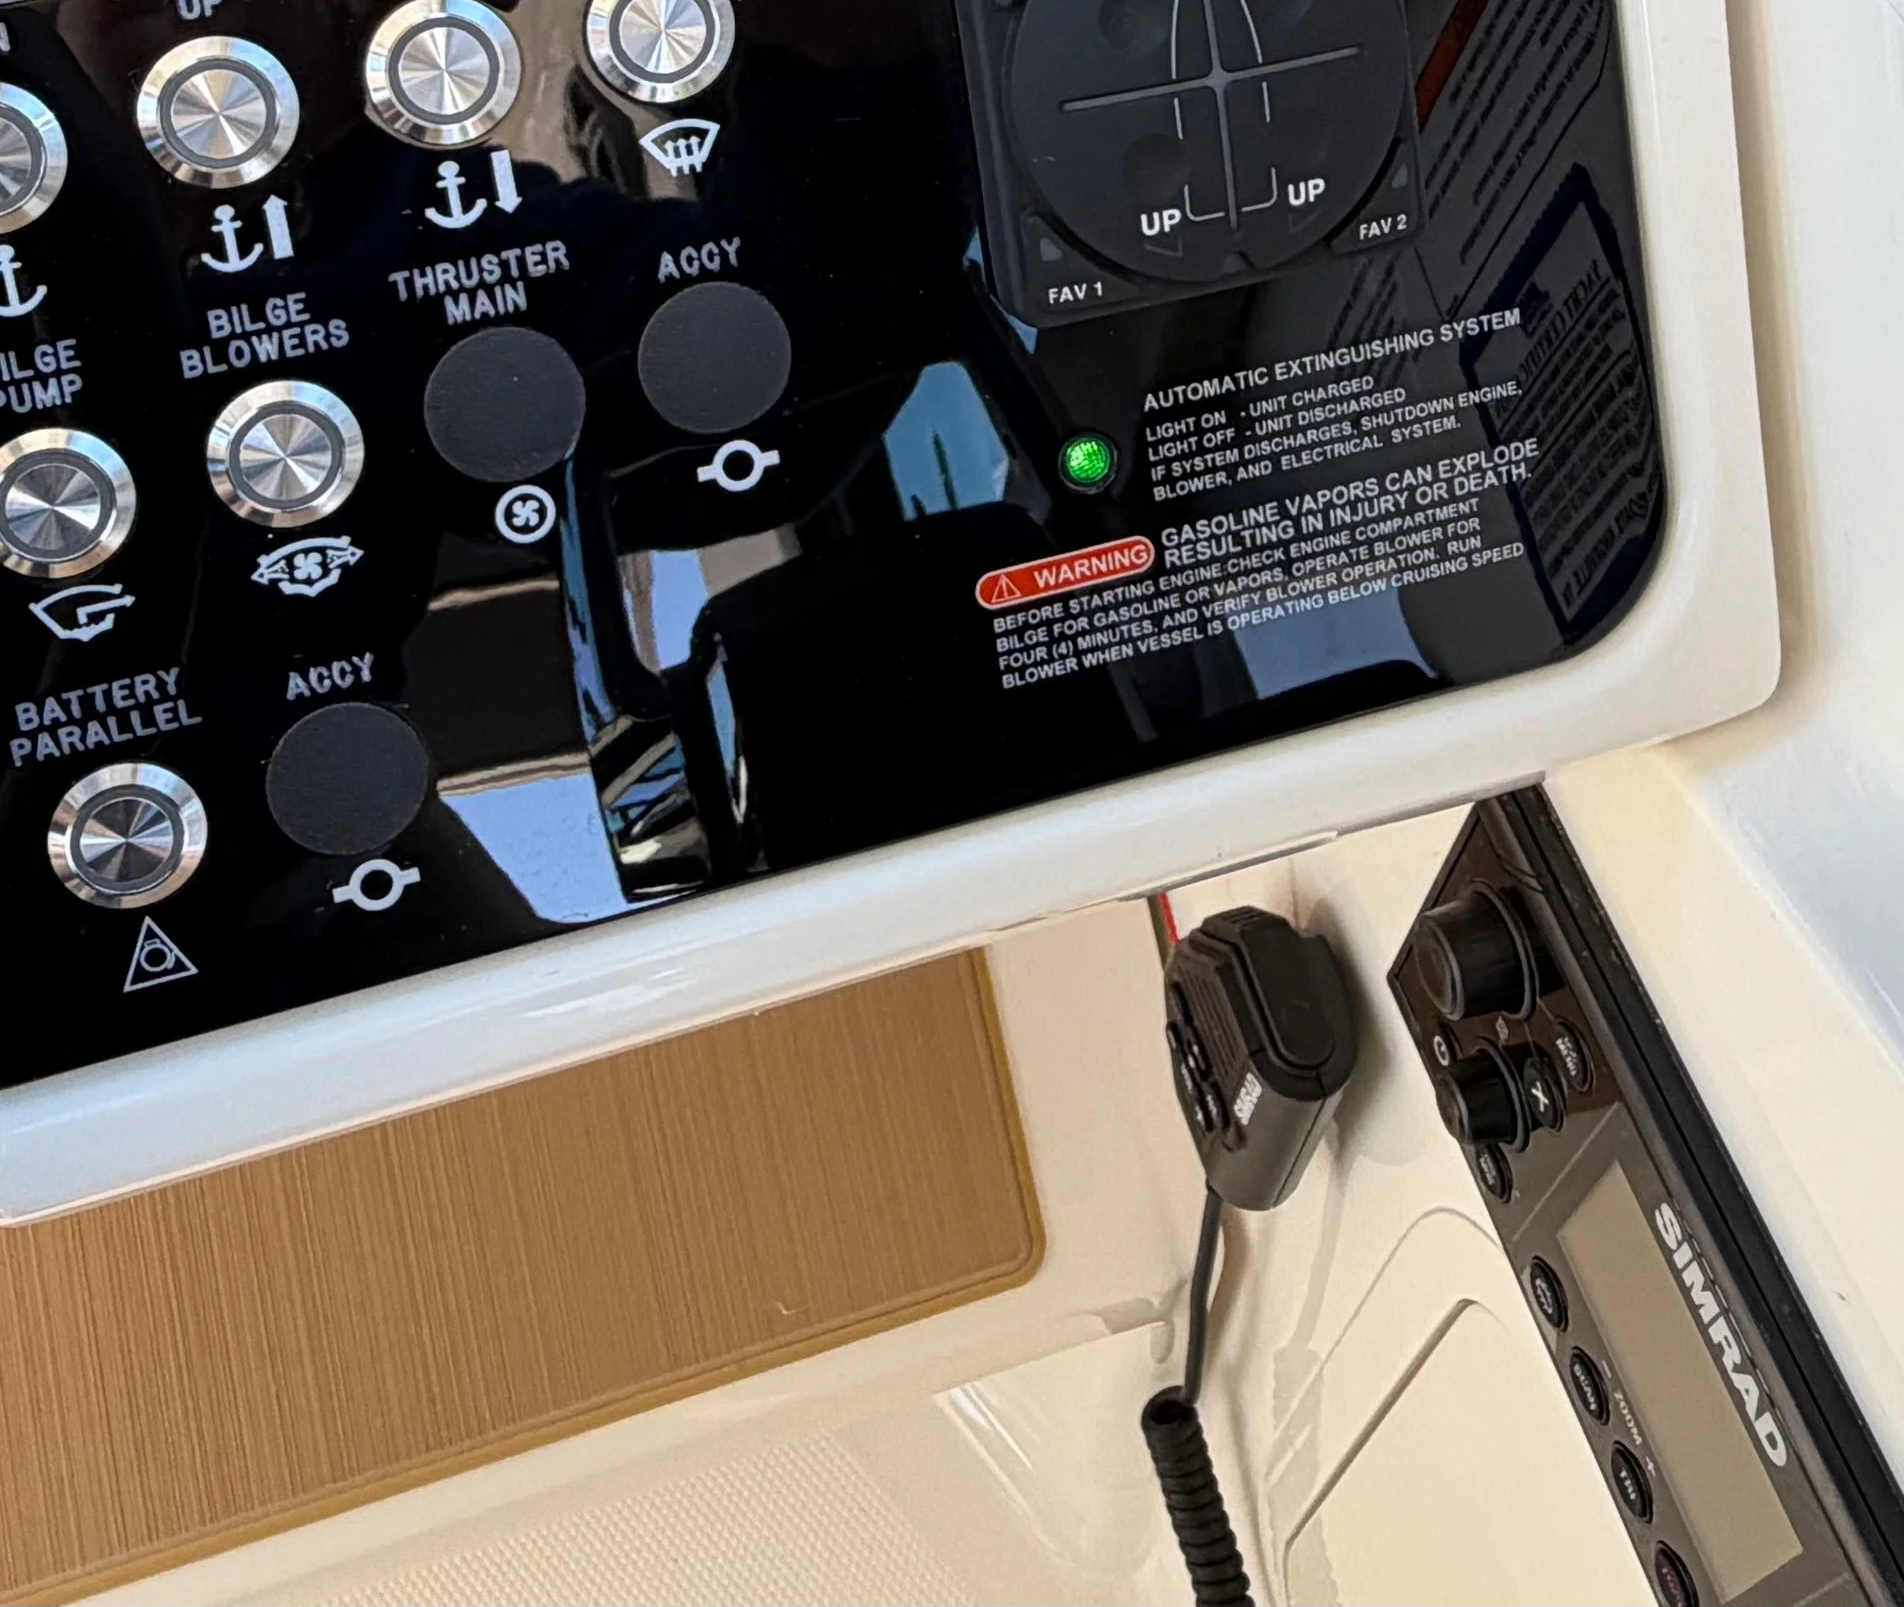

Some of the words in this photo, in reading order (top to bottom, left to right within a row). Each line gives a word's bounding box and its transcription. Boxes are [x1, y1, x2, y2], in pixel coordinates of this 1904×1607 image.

[1140, 207, 1182, 237] UP
[1287, 178, 1326, 207] UP
[1359, 218, 1392, 240] FAV
[1396, 213, 1408, 231] 2
[390, 239, 570, 304] THRUSTER
[444, 282, 529, 326] MAIN
[1048, 284, 1089, 305] FAV
[1093, 281, 1104, 297] 1
[180, 318, 351, 381] BLOWERS
[207, 292, 312, 341] BILGE
[1144, 367, 1269, 412] AUTOMATIC
[1275, 328, 1434, 381] EXTINGUISHING
[1440, 308, 1520, 342] SYSTEM
[1151, 465, 1165, 481] IF
[1172, 448, 1239, 476] SYSTEM
[1244, 422, 1357, 459] DISCHARGES,
[1361, 396, 1454, 430] SHUTDOWN
[1458, 381, 1522, 407] ENGINE,
[1154, 472, 1232, 501] BLOWER,
[1236, 460, 1272, 481] AND
[1281, 434, 1383, 470] ELECTRICAL
[1392, 415, 1461, 443] SYSTEM.
[1161, 501, 1280, 547] GASOLINE
[1285, 478, 1379, 516] VAPORS
[1385, 464, 1432, 491] CAN
[1438, 437, 1539, 479] EXPLODE
[1164, 520, 1295, 569] RESULTING
[1301, 513, 1323, 534] IN
[1329, 490, 1409, 527] INJURY
[1415, 482, 1449, 505] OR
[1454, 462, 1532, 496] DEATH.
[996, 626, 1049, 652] BILGE
[1053, 618, 1090, 638] FOR
[1093, 593, 1181, 627] GASOLINE
[1185, 587, 1210, 604] OR
[1213, 568, 1288, 596] VAPORS,
[1291, 545, 1369, 577] OPERATE
[1374, 527, 1444, 556] BLOWER
[1447, 518, 1481, 537] FOR
[1034, 544, 1149, 589] WARNING
[15, 666, 184, 733] BATTERY
[10, 699, 203, 768] PARALLEL
[1655, 1203, 1789, 1467] SIMRAD
